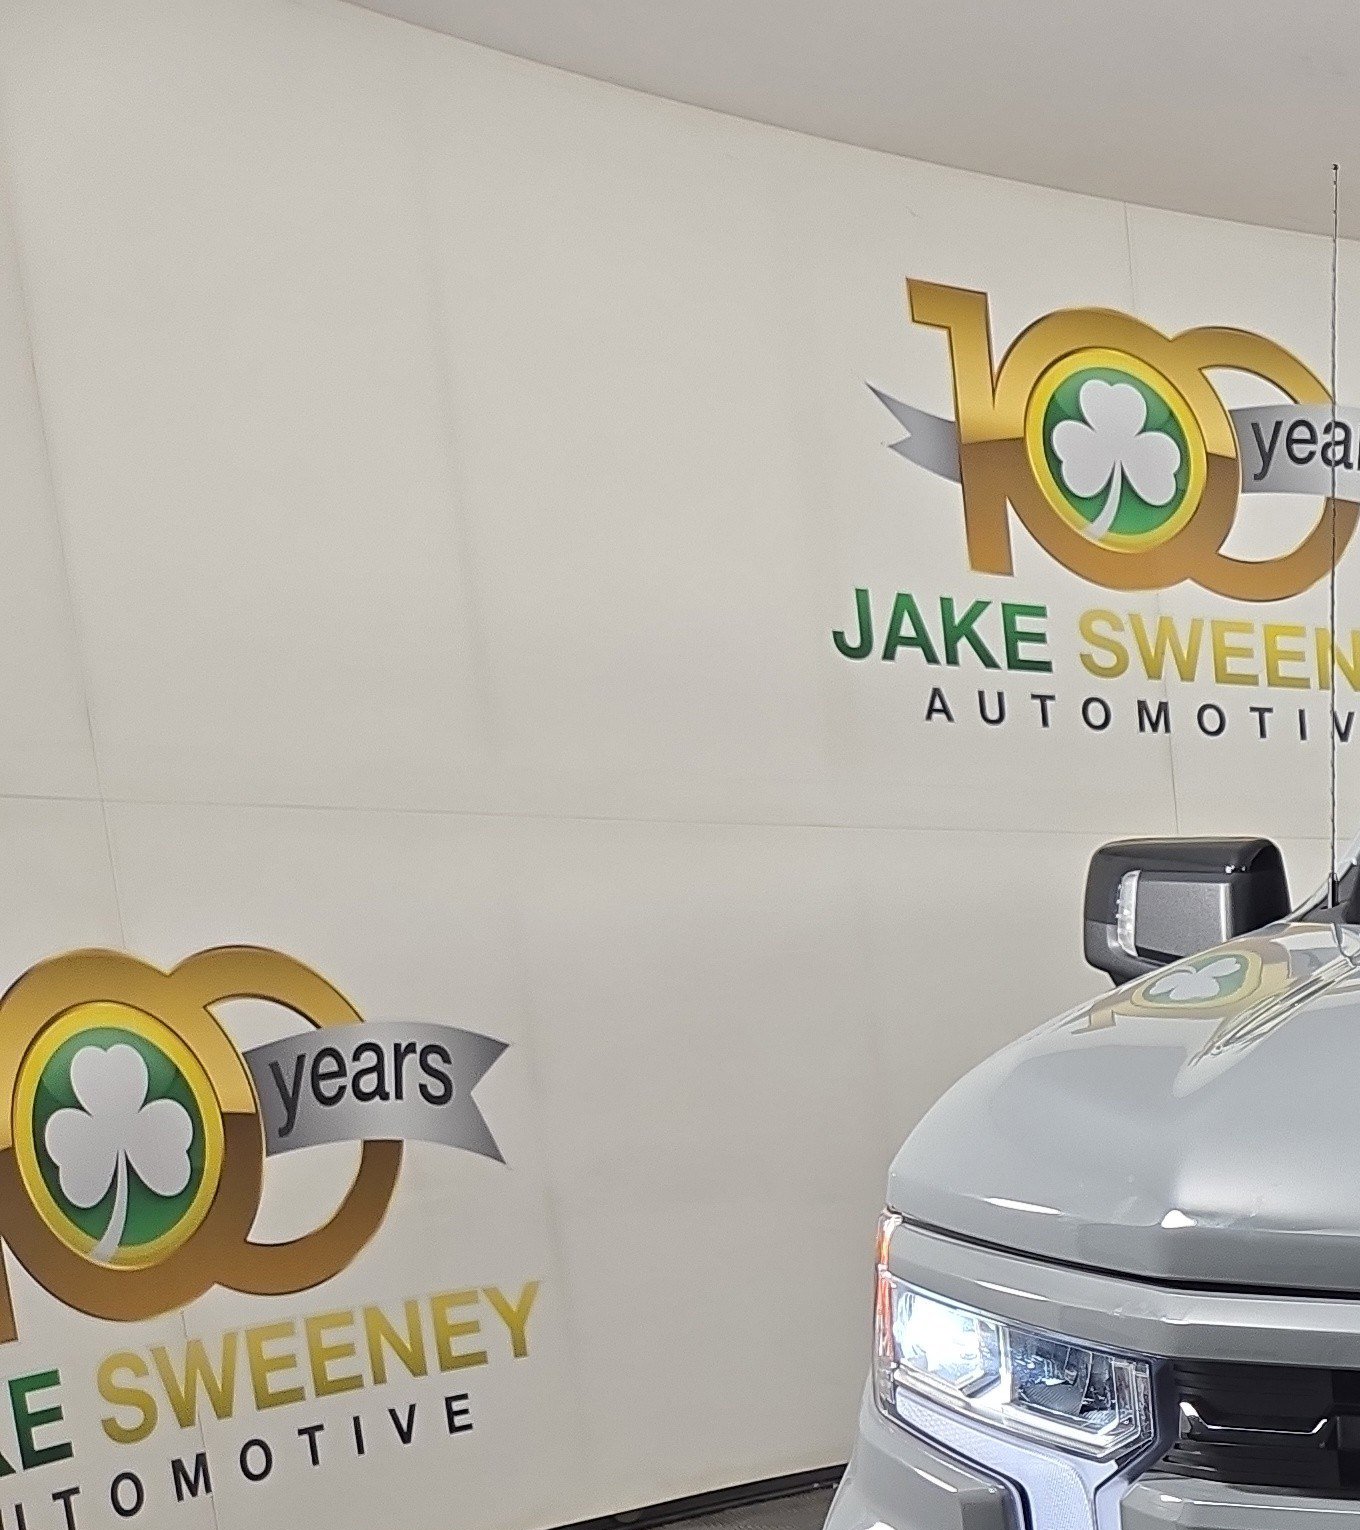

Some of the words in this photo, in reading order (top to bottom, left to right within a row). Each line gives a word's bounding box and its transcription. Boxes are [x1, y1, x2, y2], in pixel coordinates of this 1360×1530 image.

[832, 588, 1054, 673] JAKE
[0, 944, 404, 1342] 00
[268, 1039, 454, 1138] years
[97, 1281, 541, 1445] SWEENEY
